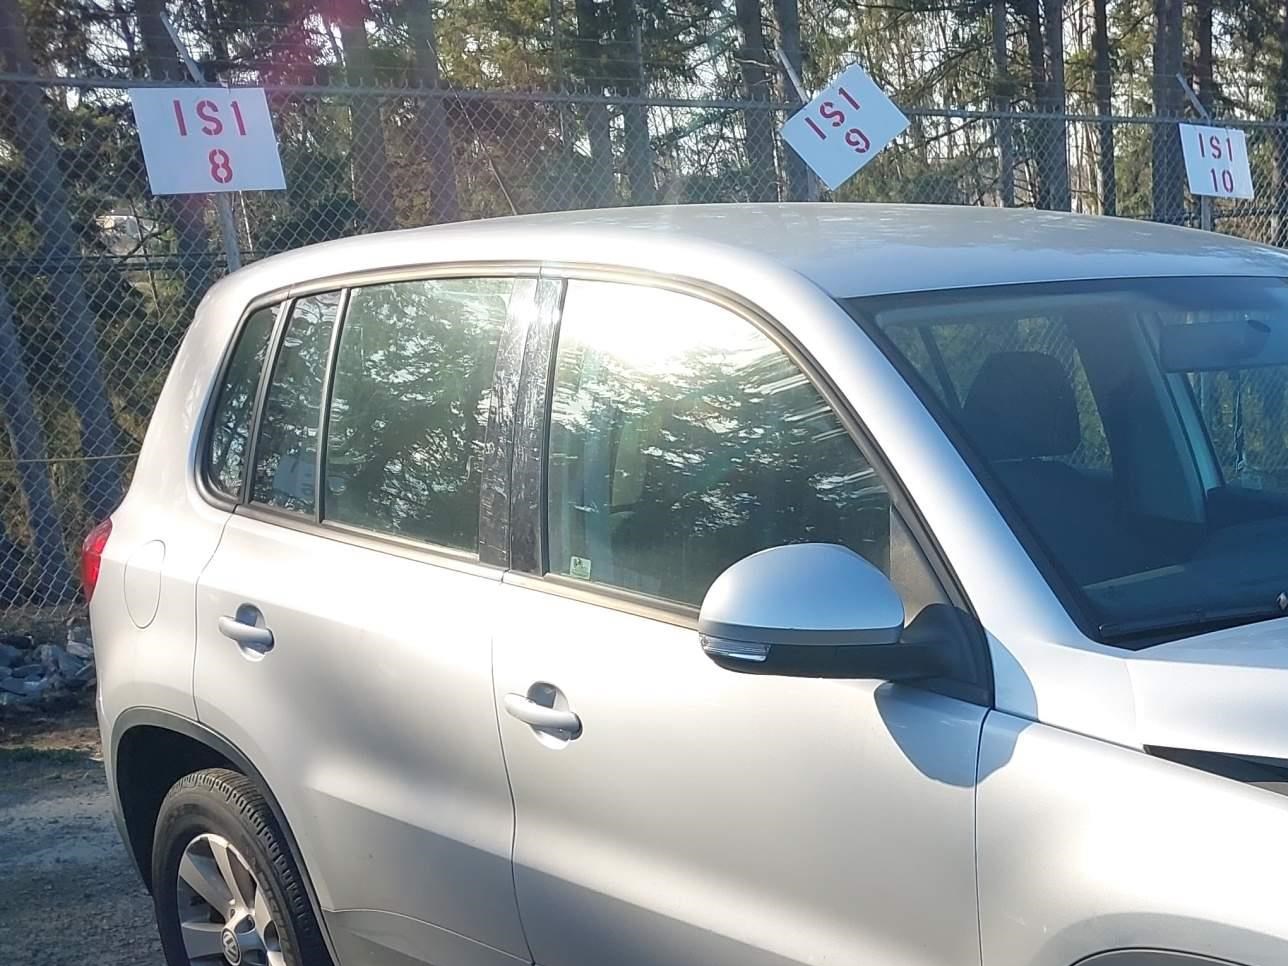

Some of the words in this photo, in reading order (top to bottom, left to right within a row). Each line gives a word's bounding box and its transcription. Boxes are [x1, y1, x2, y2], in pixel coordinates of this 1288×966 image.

[845, 128, 870, 153] 9
[208, 149, 233, 184] 8
[1211, 168, 1234, 193] 10
